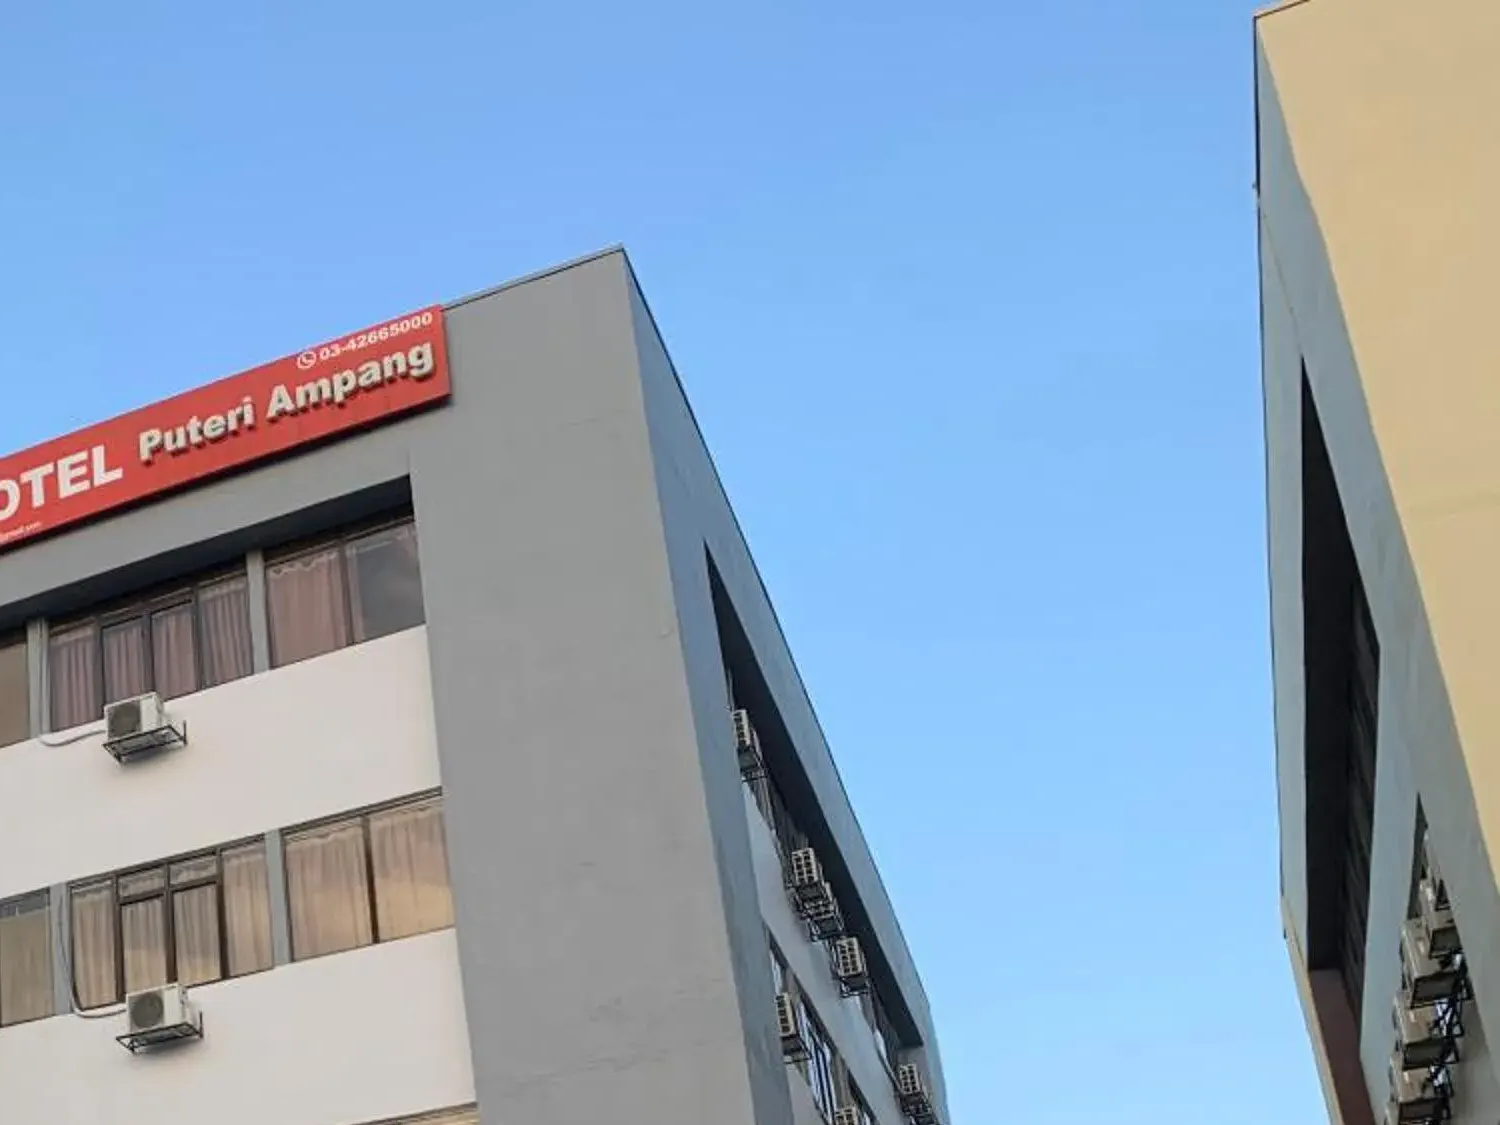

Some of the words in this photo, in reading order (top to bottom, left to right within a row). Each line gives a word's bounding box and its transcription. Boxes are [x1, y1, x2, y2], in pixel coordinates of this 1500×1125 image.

[320, 312, 433, 360] 03-42665000
[138, 397, 256, 462] Puteri
[266, 341, 434, 419] Ampang
